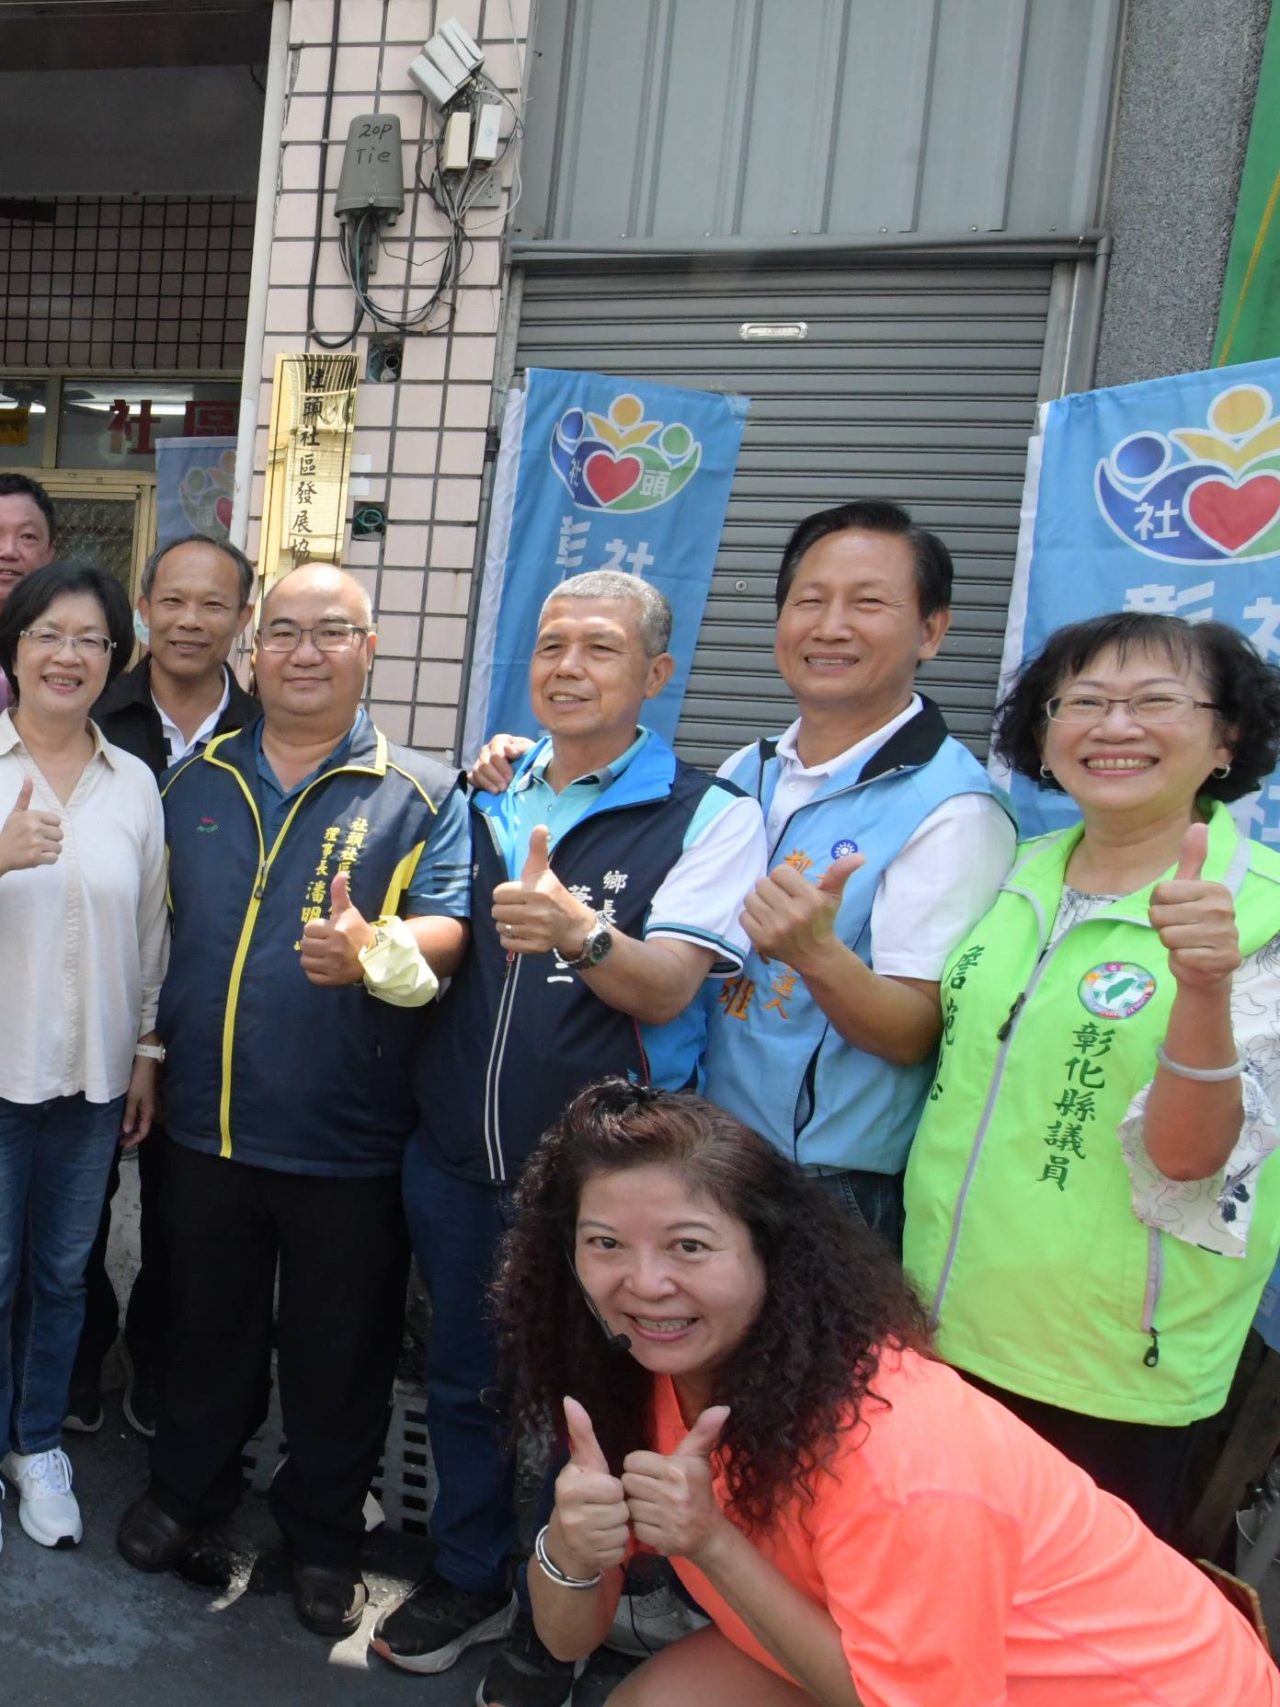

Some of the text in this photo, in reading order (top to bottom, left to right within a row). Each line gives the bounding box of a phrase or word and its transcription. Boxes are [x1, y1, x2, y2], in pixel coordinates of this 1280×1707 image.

[639, 469, 671, 498] 頭
[1134, 500, 1181, 541] 社
[315, 826, 340, 876] 理事長
[603, 870, 628, 924] 鄉長
[1036, 1021, 1116, 1192] 彰化縣議員
